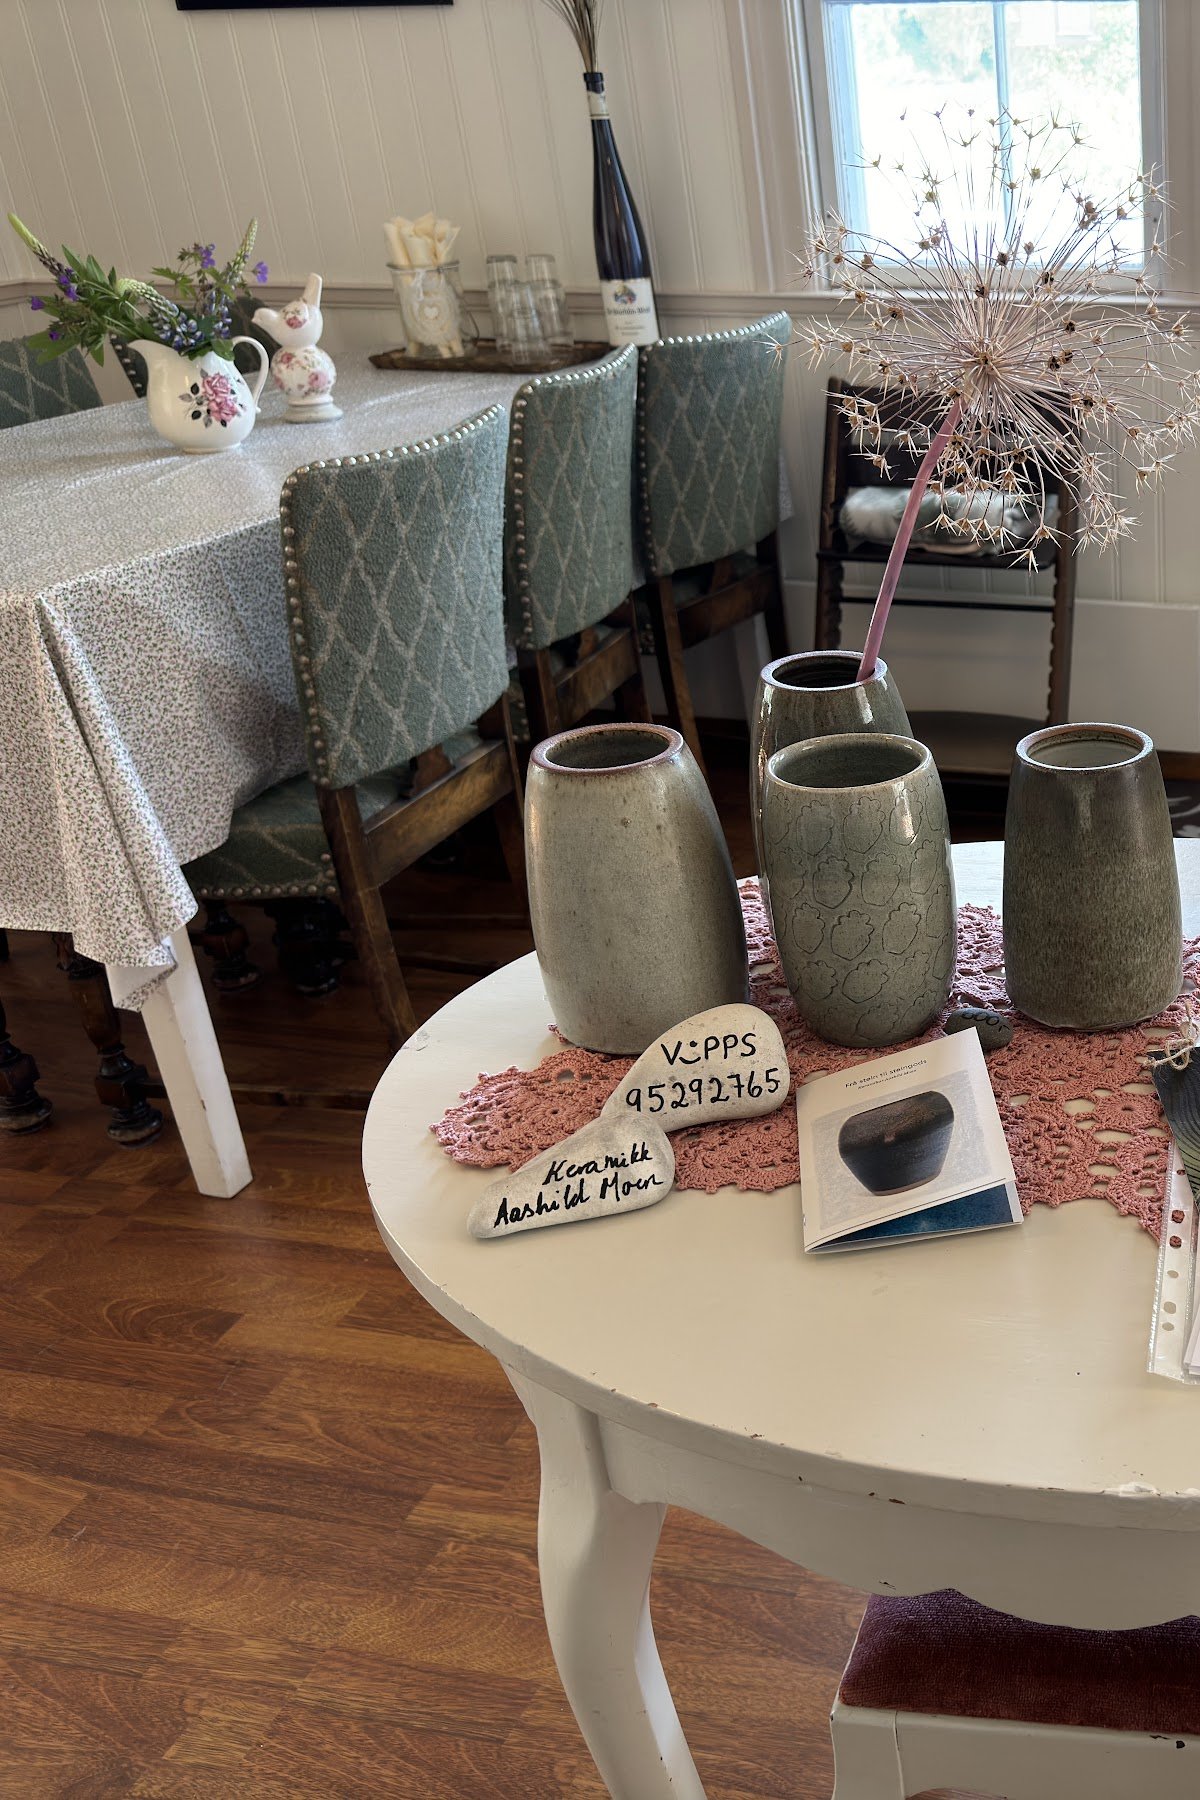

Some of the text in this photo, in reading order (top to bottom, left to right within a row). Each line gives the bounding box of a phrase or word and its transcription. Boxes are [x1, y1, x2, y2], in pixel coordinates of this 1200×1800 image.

[625, 1067, 781, 1113] 95292765
[542, 1141, 653, 1186] Keramikk
[493, 1173, 664, 1229] Aashild Moen
